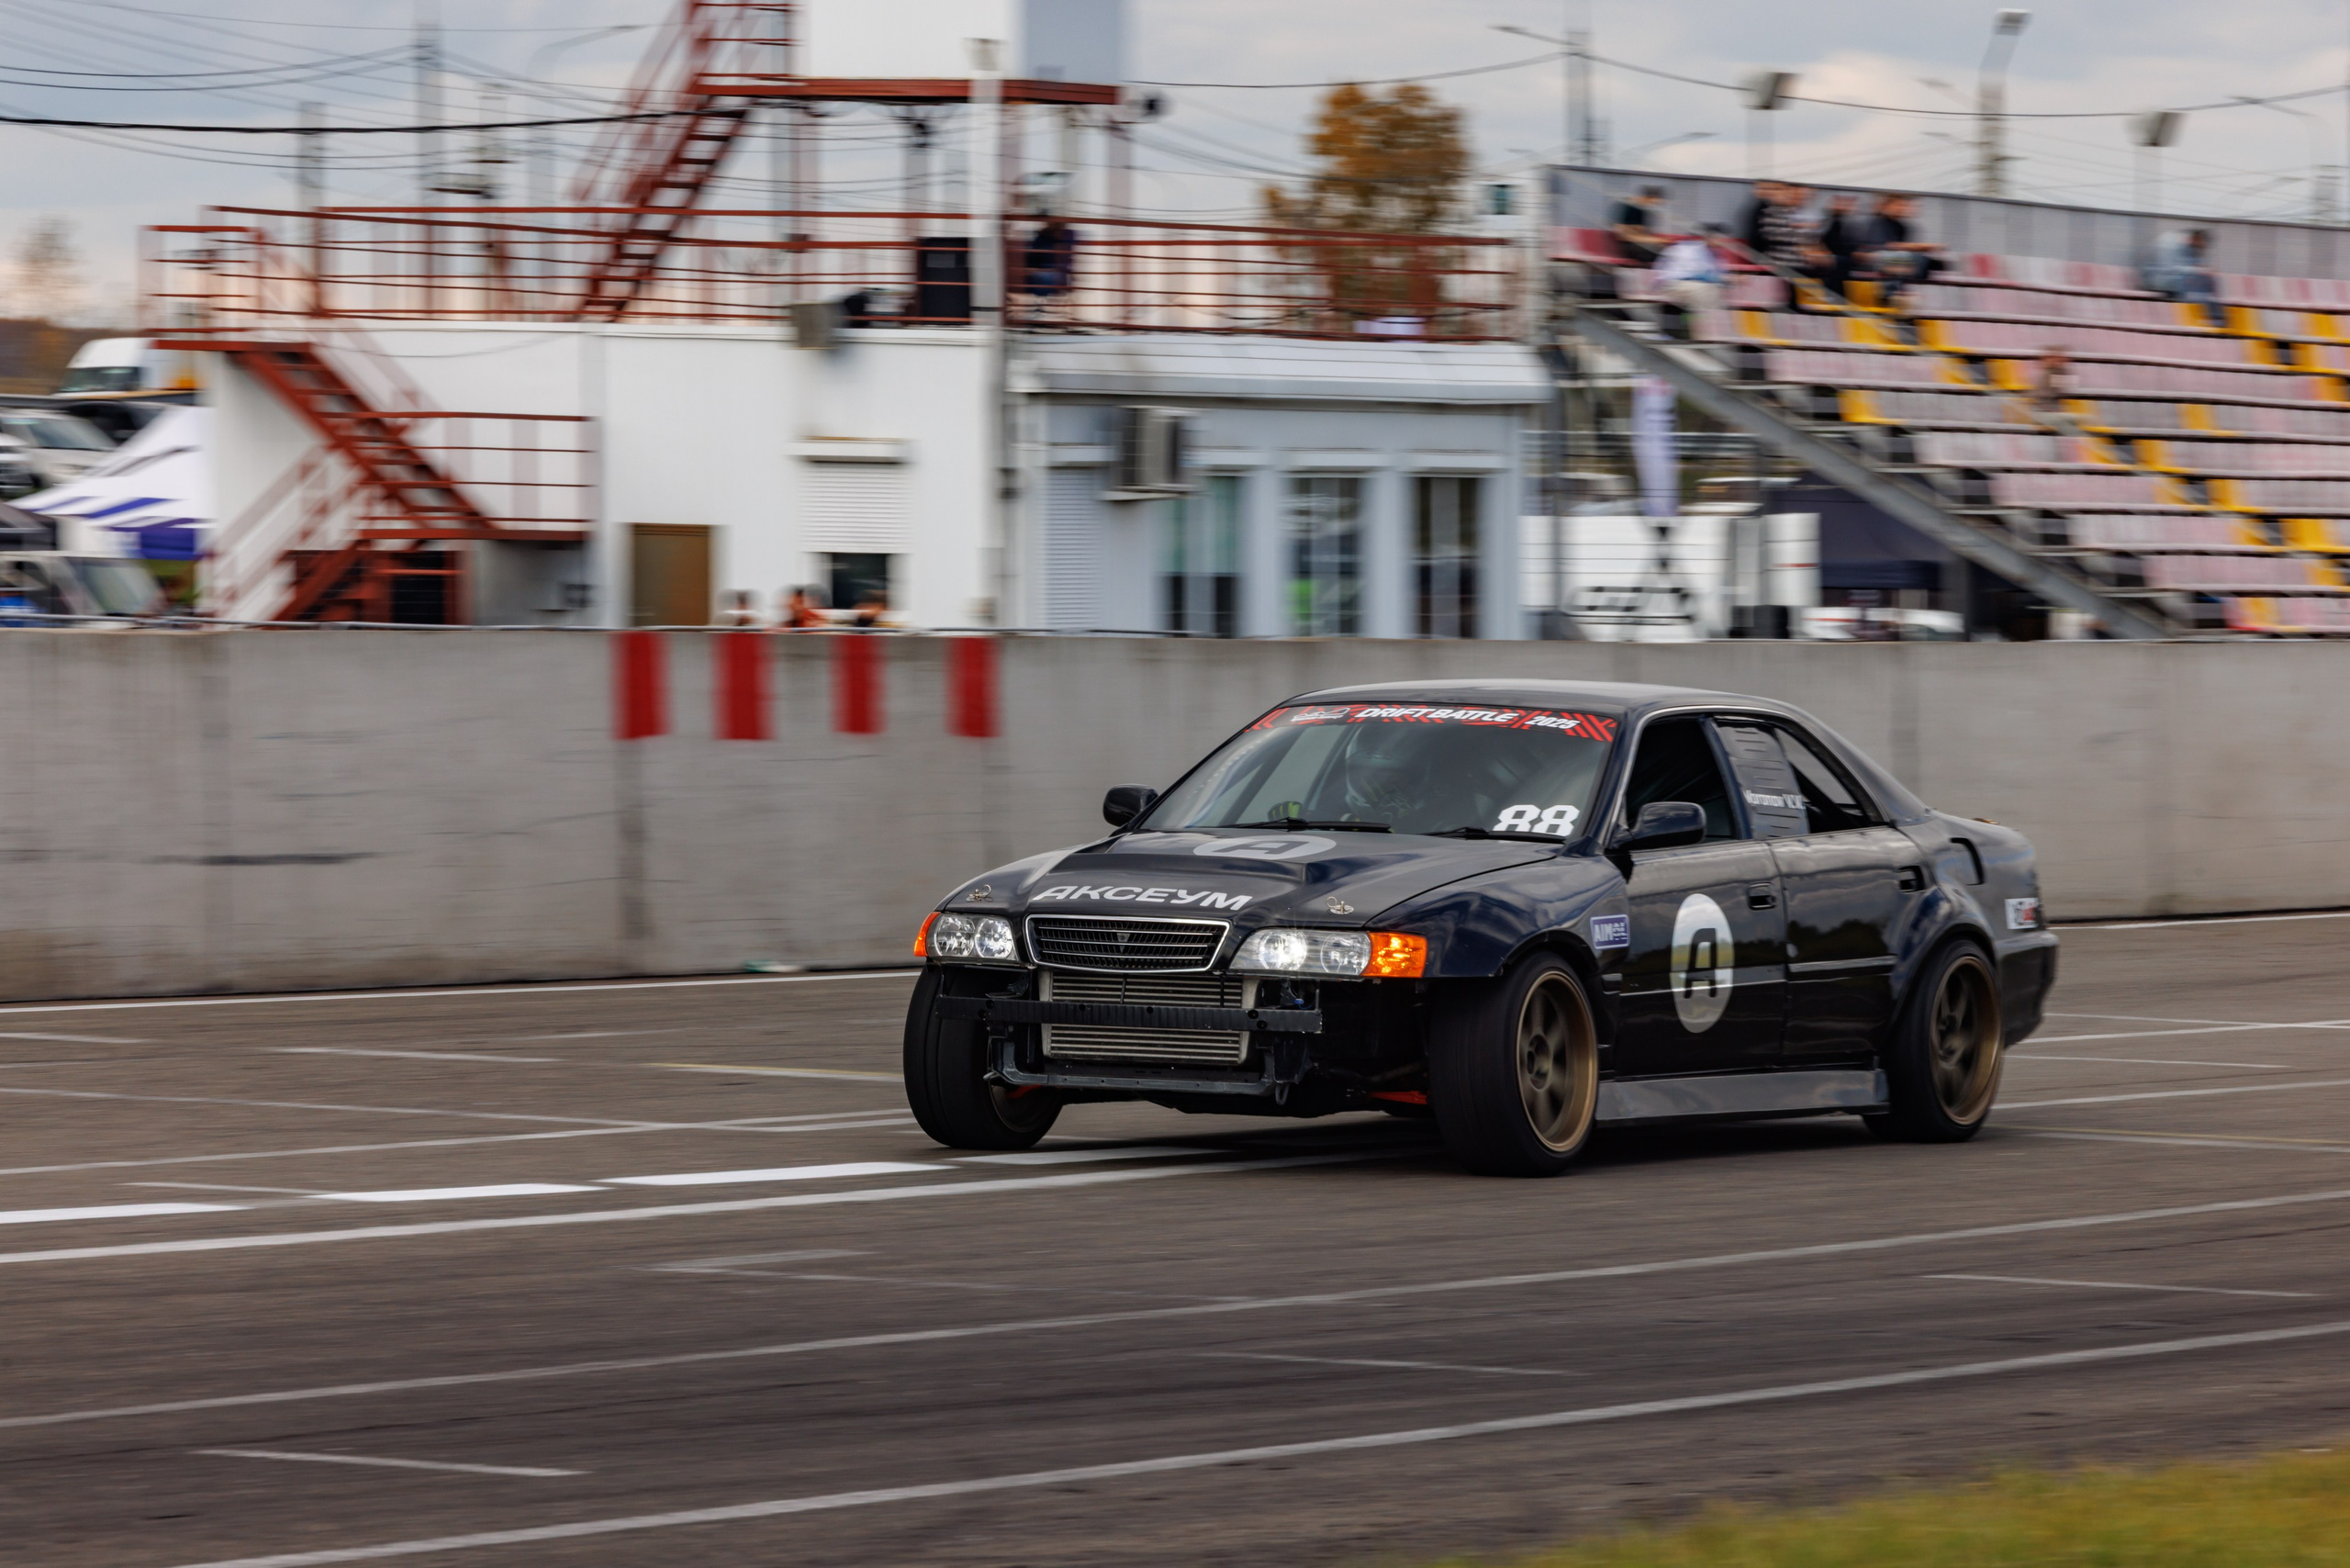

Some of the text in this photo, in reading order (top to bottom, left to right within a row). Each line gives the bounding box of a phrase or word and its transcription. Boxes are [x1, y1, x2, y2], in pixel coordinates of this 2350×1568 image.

[1354, 708, 1581, 729] DRIFT BATTLE 2025
[1492, 804, 1581, 836] 88
[1033, 885, 1253, 911] АКСЕУМ
